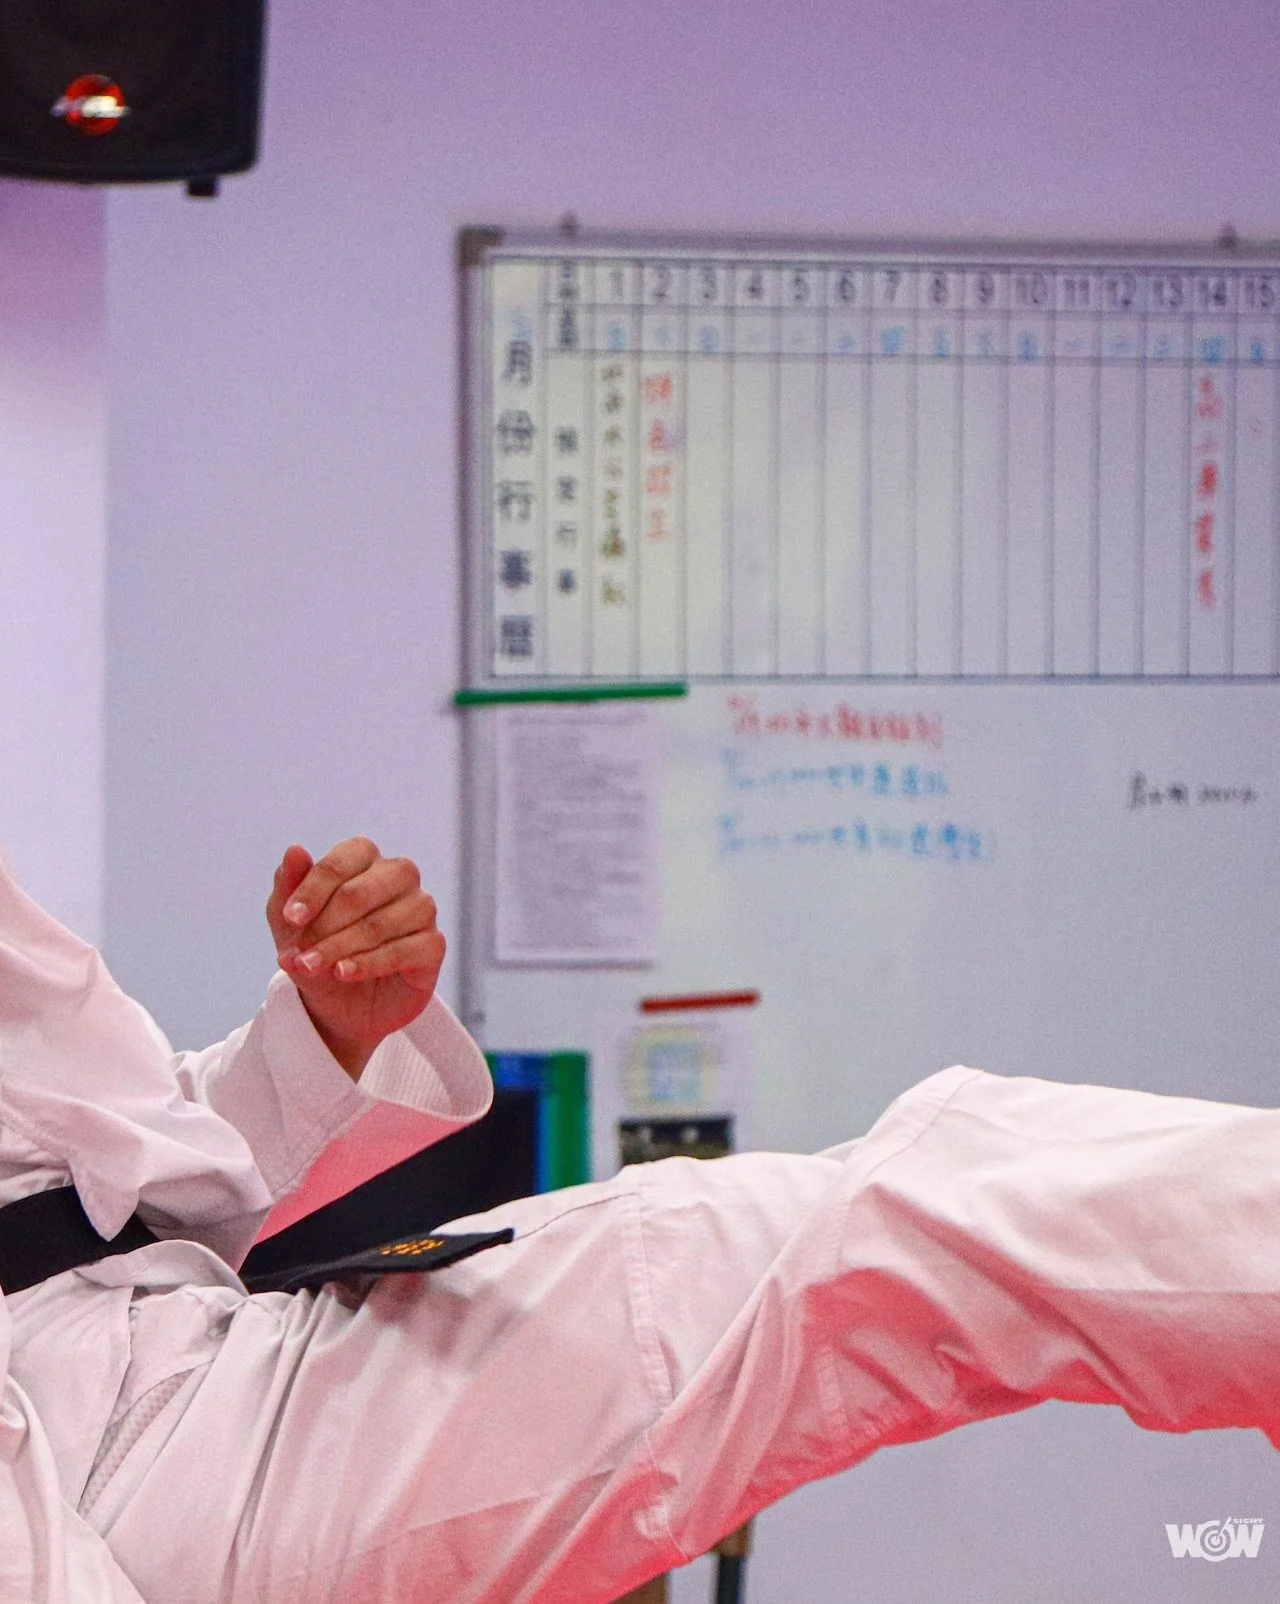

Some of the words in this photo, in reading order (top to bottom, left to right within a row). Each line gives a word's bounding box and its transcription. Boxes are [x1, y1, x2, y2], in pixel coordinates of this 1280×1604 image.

[653, 268, 674, 299] 2
[700, 268, 718, 300] 3
[746, 268, 765, 300] 4
[793, 268, 811, 301] 5
[834, 268, 854, 301] 6
[884, 269, 902, 301] 7
[930, 271, 948, 303] 8
[976, 272, 995, 303] 9
[1019, 273, 1048, 304] 10
[1066, 276, 1090, 304] 11
[1108, 273, 1137, 307] 12
[1153, 275, 1182, 307] 13
[1199, 275, 1227, 307] 14
[1246, 276, 1273, 308] 15
